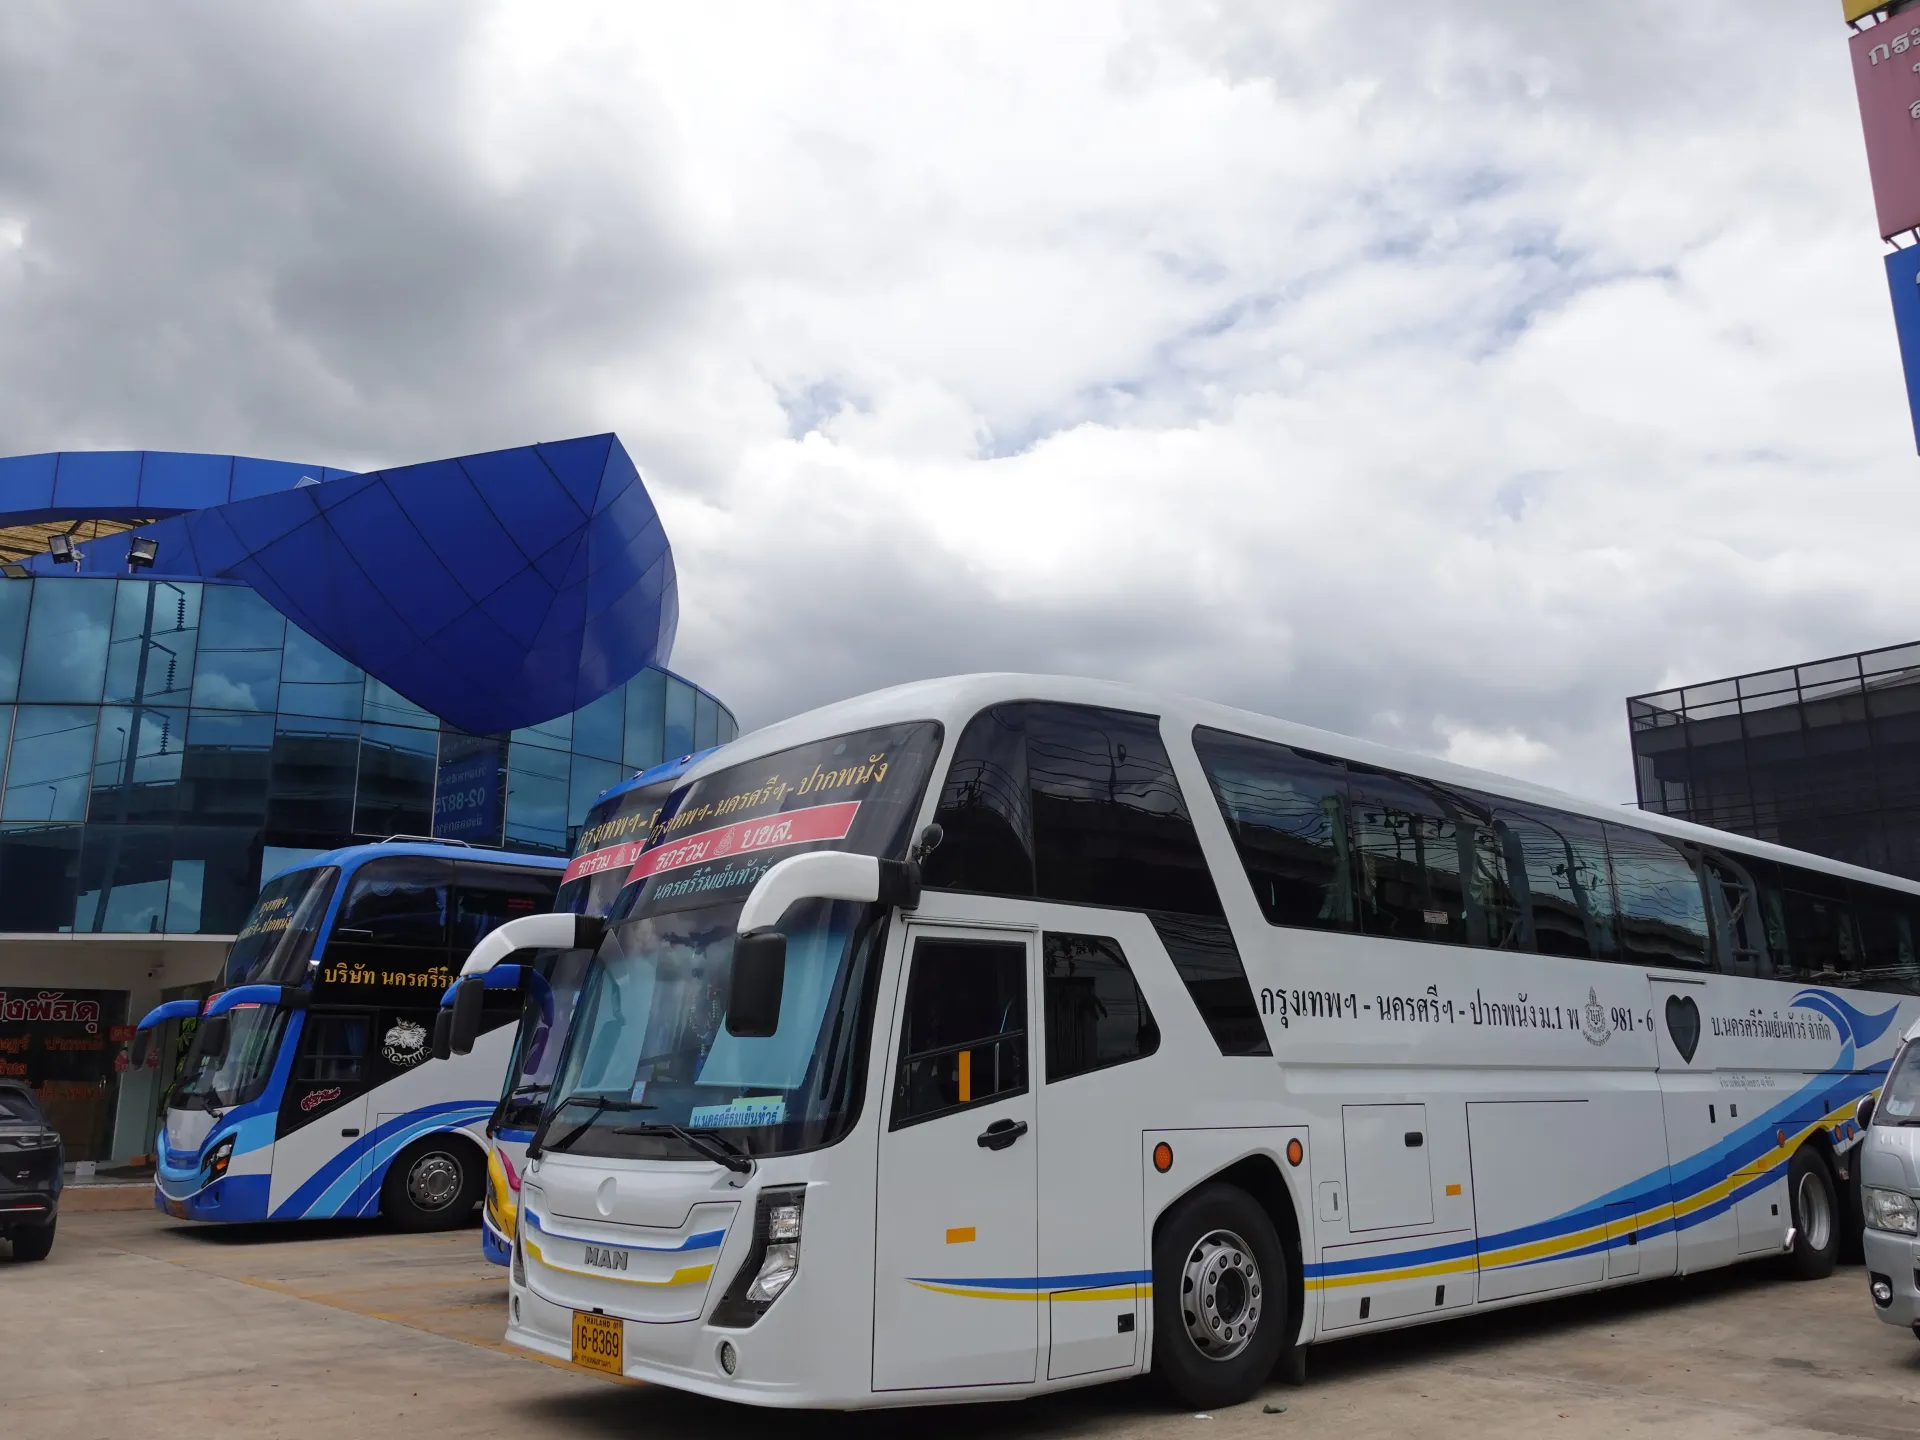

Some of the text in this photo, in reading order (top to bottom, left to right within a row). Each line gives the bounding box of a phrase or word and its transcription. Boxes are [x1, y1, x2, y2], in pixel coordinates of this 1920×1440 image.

[656, 820, 793, 871] รถร่วม บขส.
[578, 853, 611, 875] รถร่วม
[324, 962, 375, 984] บริษัท
[1260, 987, 1357, 1029] กรุงเทพฯ
[1377, 984, 1454, 1024] นครศรีฯ
[382, 1046, 433, 1067] SCANIA
[584, 1245, 629, 1271] MAN
[584, 1315, 611, 1329] THAILAND
[576, 1324, 619, 1358] 16-8369
